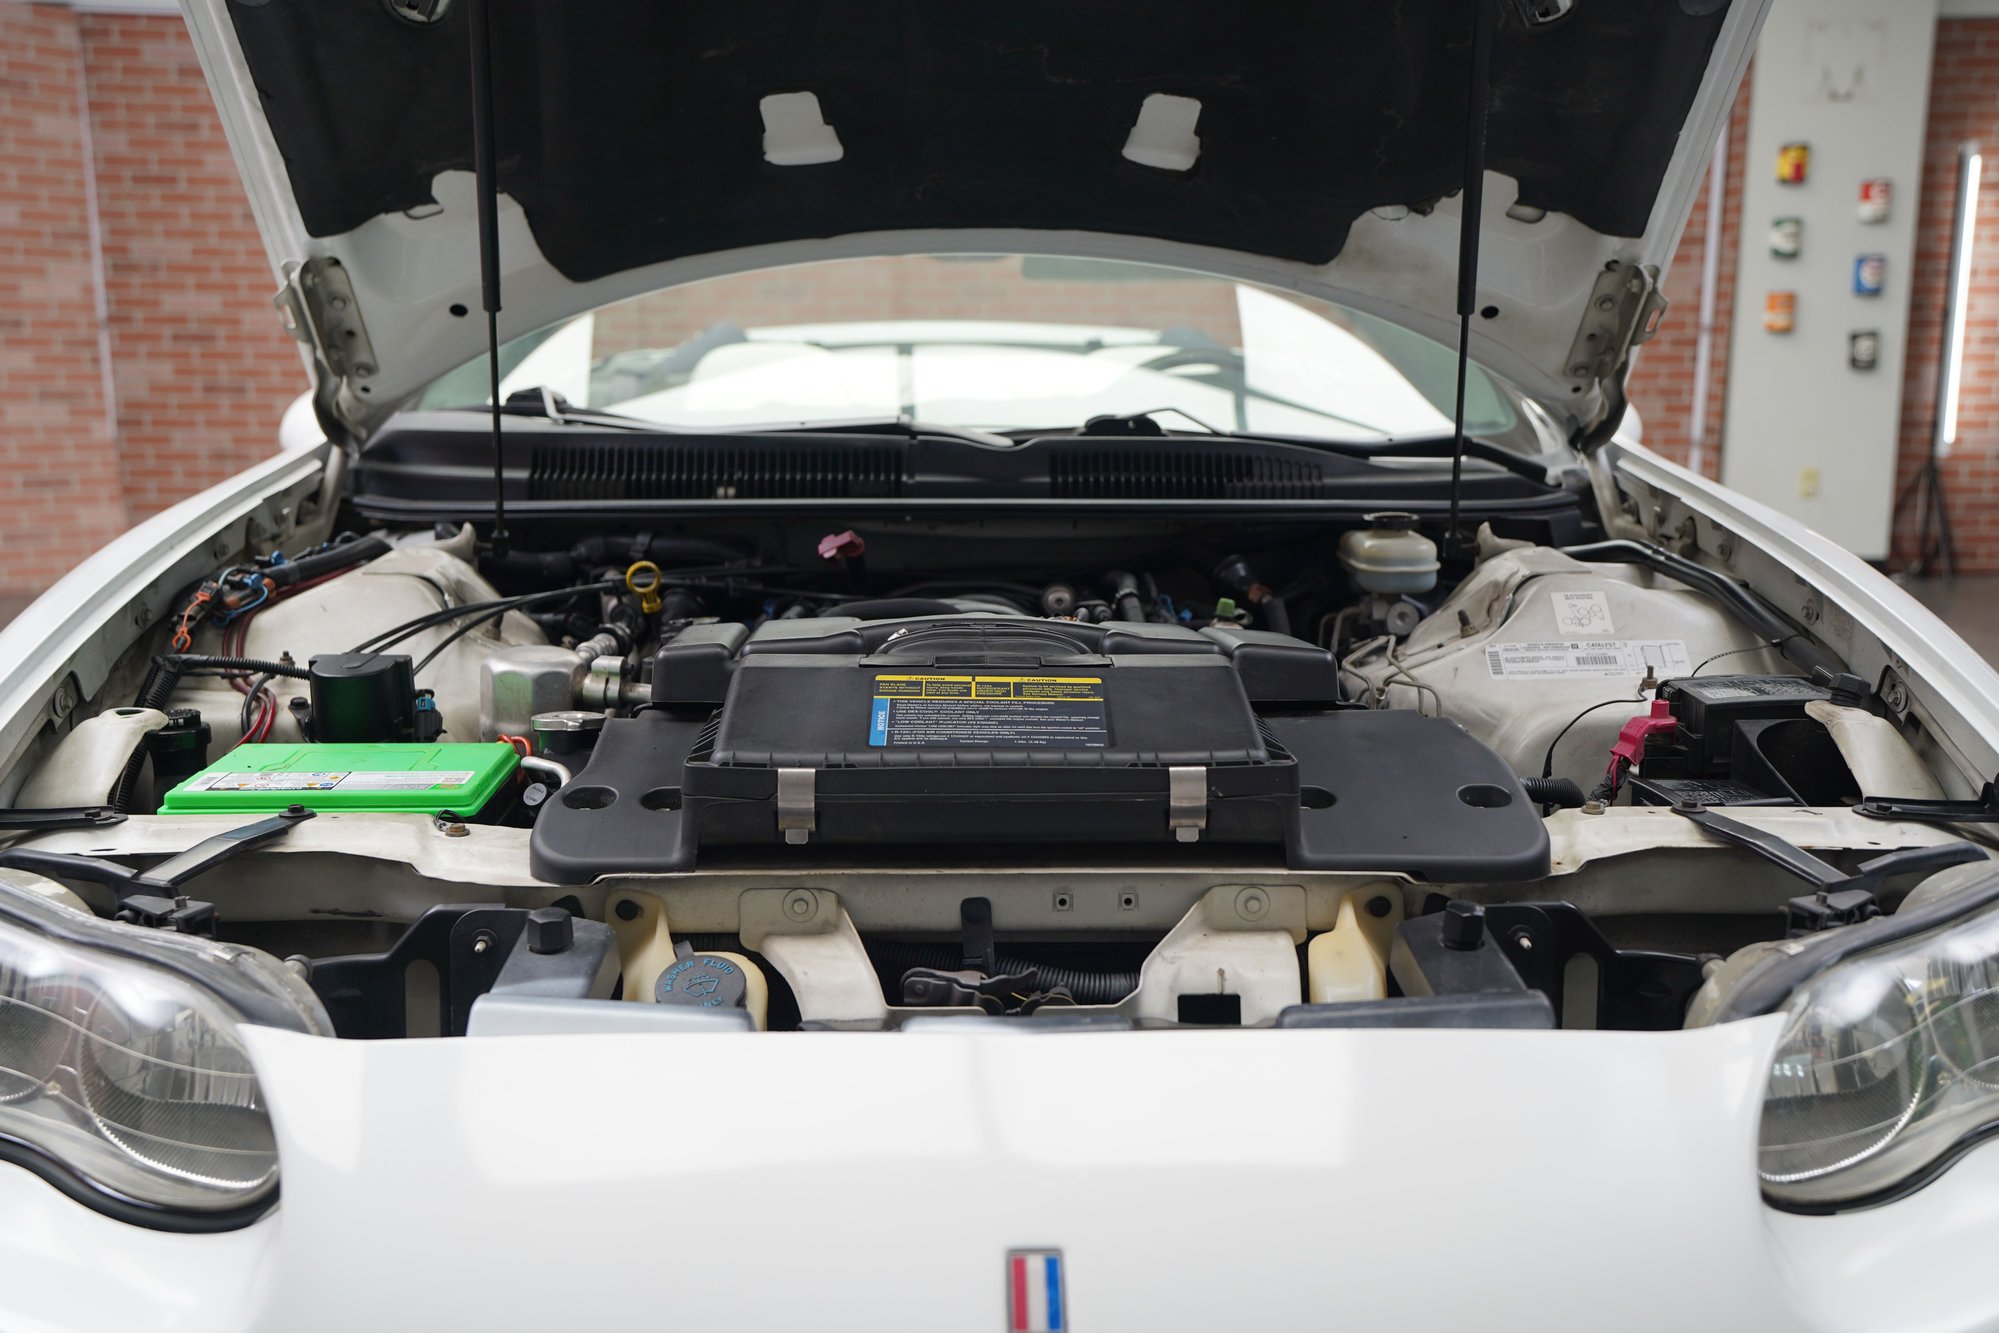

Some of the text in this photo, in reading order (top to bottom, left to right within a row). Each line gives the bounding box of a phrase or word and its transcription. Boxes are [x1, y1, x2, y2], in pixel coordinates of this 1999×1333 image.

[877, 711, 886, 731] NOTICE
[663, 958, 734, 993] WASHER FLUID
